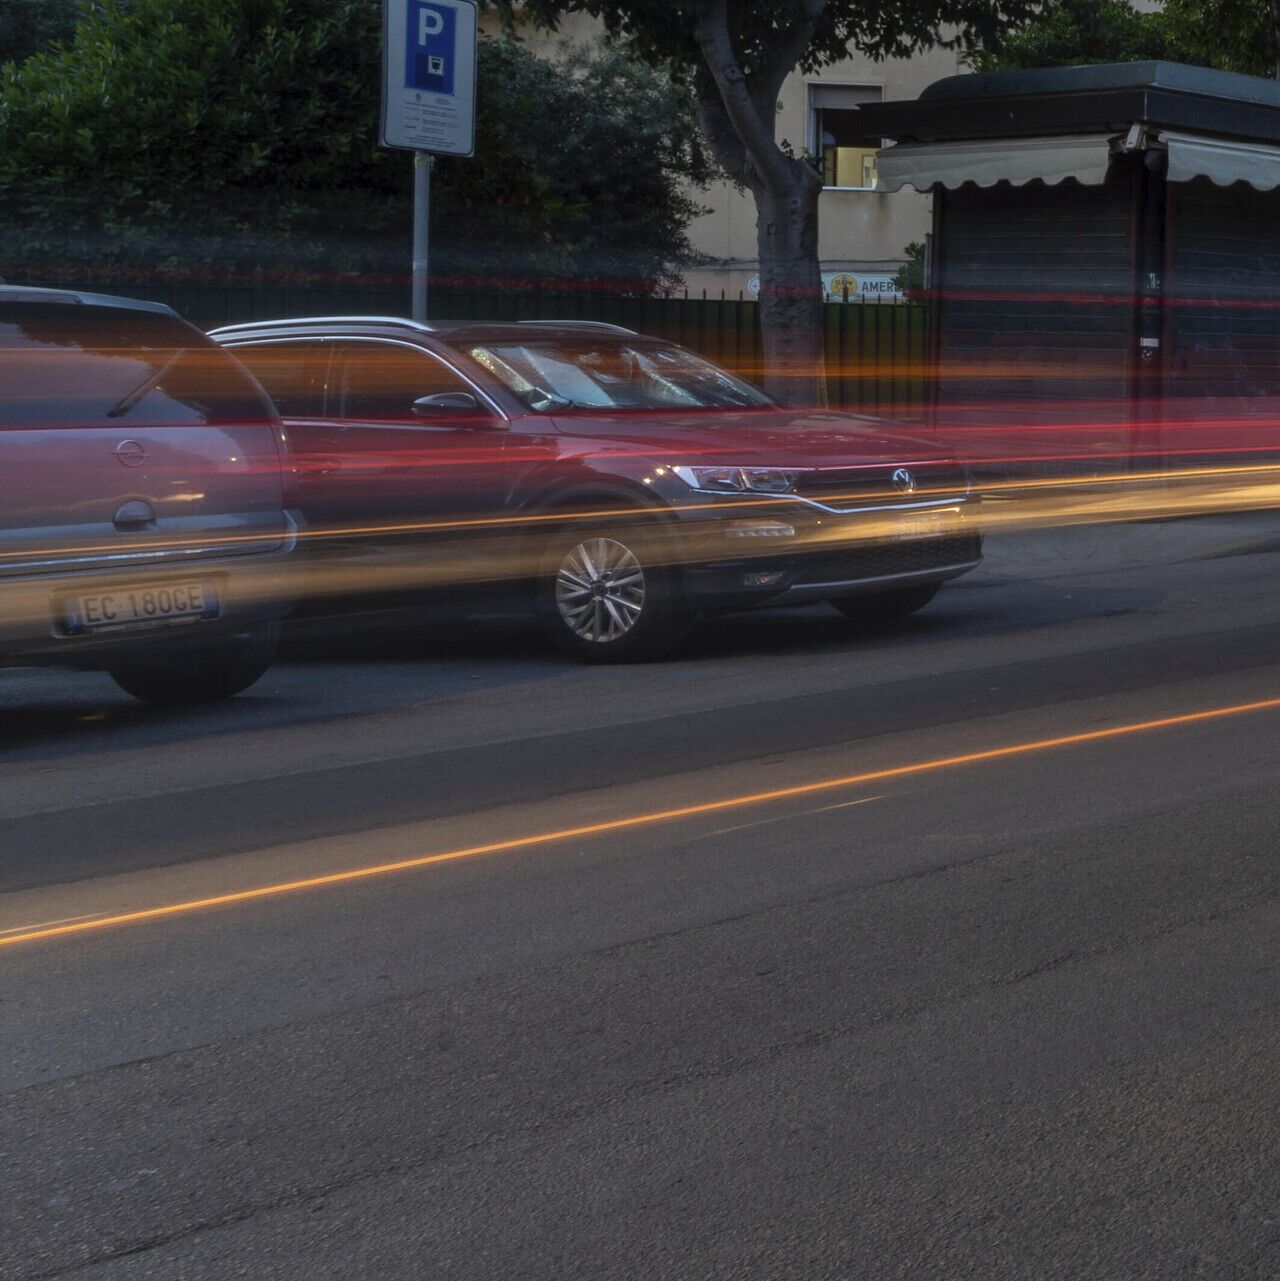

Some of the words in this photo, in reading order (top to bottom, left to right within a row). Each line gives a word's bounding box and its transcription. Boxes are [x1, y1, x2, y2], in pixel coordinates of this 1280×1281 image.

[418, 7, 444, 46] P
[862, 281, 896, 292] AMER
[84, 596, 117, 621] EC
